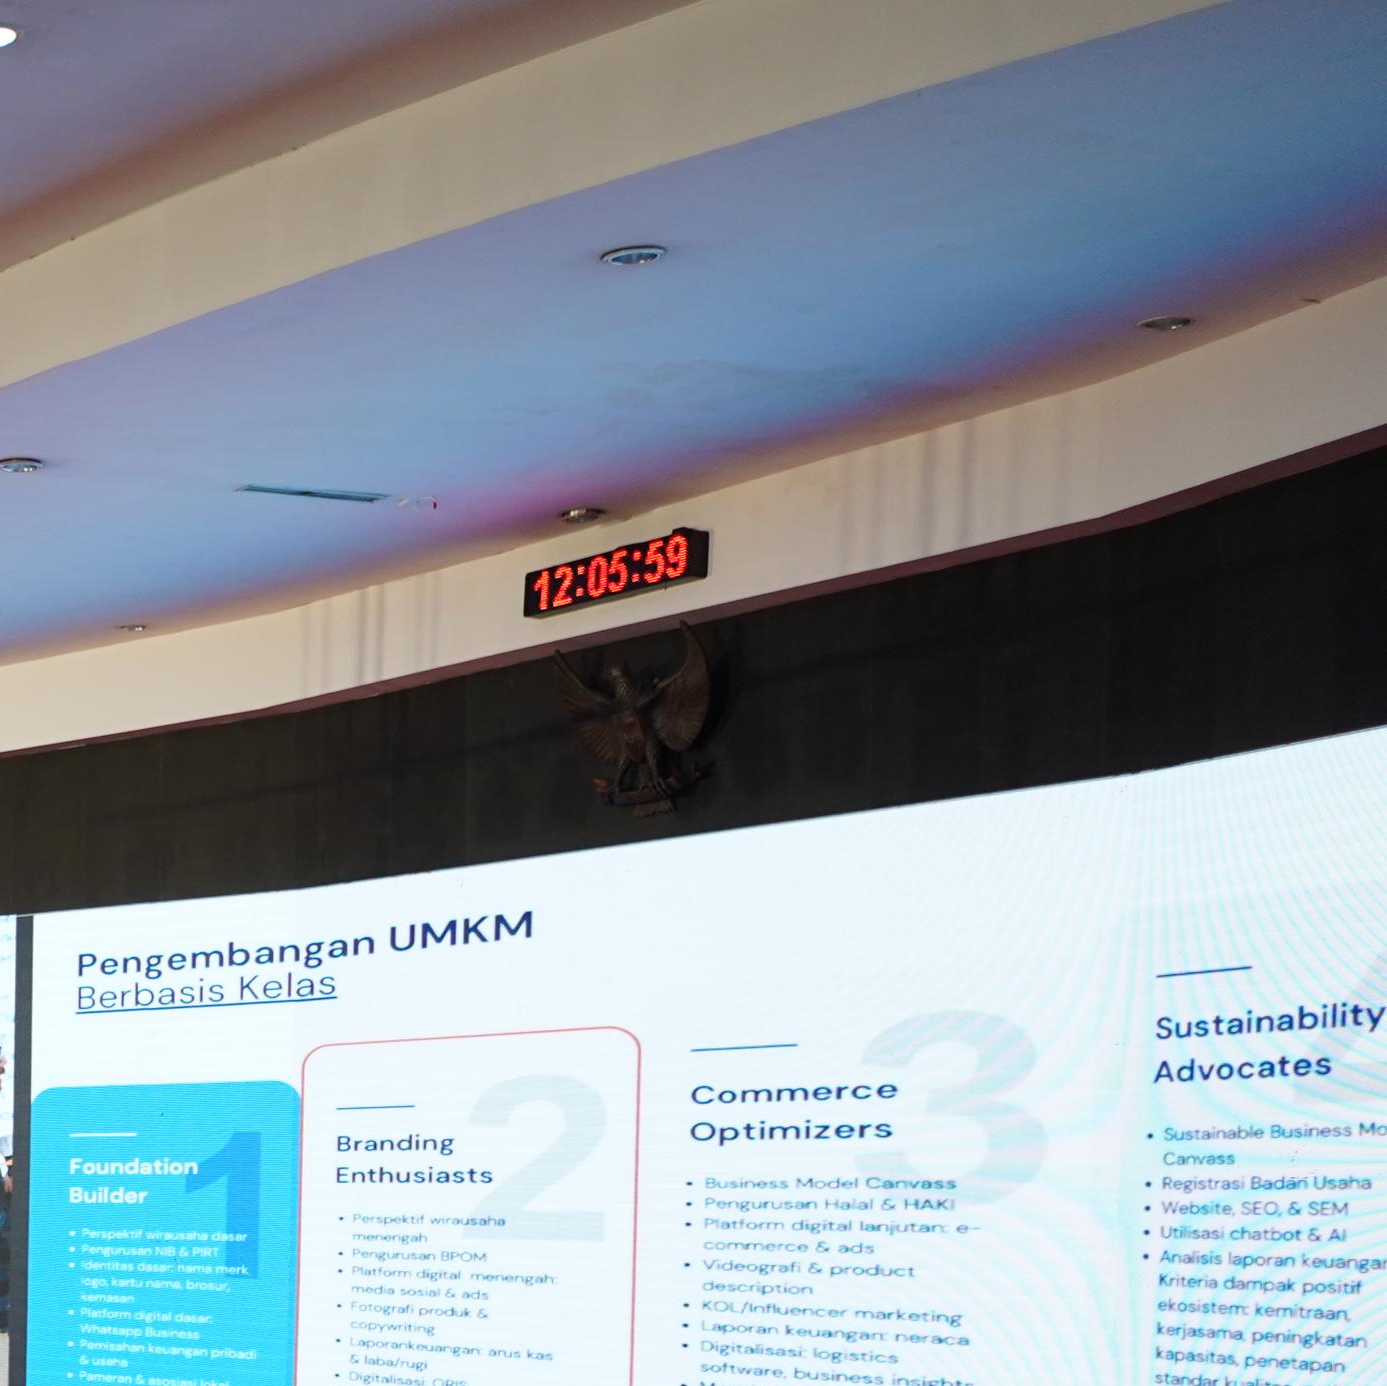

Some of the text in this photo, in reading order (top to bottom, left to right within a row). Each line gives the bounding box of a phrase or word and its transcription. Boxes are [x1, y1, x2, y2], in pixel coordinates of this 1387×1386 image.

[532, 534, 689, 610] 12:05:59
[78, 911, 533, 980] Pengembangan UMKM
[77, 973, 336, 1010] Berbasis Kelas
[1157, 1002, 1386, 1039] Sustainability
[1155, 1056, 1332, 1084] Advocates
[691, 1080, 898, 1105] Commerce
[854, 1009, 1048, 1205] 3
[690, 1120, 893, 1145] Optimizers
[1164, 1125, 1352, 1141] Sustainable Business
[337, 1134, 455, 1156] Branding
[461, 1073, 607, 1241] 2
[1163, 1152, 1235, 1165] Canvass
[70, 1158, 198, 1175] Foundation
[336, 1166, 493, 1183] Enthusiasts
[705, 1177, 956, 1190] Business Model Canvass
[1162, 1176, 1372, 1193] Registrasi Badan Usaha
[70, 1187, 148, 1203] Builder
[185, 1131, 261, 1279] 1
[705, 1198, 955, 1214] Pengurusan Halal & HAKI
[1288, 1202, 1301, 1215] &
[1308, 1202, 1349, 1215] SEM
[353, 1213, 505, 1226] Perspektif wirausaha
[704, 1218, 785, 1232] Platform
[791, 1219, 853, 1236] digital
[82, 1228, 247, 1242] Perspektif wirausaha dasar
[352, 1232, 427, 1245] menengah
[1161, 1226, 1346, 1241] Utilisasi chatbot & AI
[82, 1244, 219, 1257] Pengurusan NIB & PIRT
[703, 1239, 874, 1254] commerce & ads
[352, 1249, 487, 1263] Pengurusan BPOM
[1160, 1250, 1295, 1269] Analisis laporan
[178, 1264, 213, 1273] nama
[352, 1266, 461, 1282] Platform digital
[703, 1259, 915, 1281] Videografi & product
[112, 1278, 143, 1288] kartu
[703, 1279, 813, 1299] description
[1159, 1274, 1362, 1295] Kriteria dampak positif
[81, 1293, 135, 1303] kemasan
[352, 1284, 489, 1300] media sosial & ads
[81, 1308, 172, 1323] Platform digital
[351, 1301, 488, 1319] Fotografi produk &
[702, 1300, 963, 1327] KOL/Influencer marketing
[80, 1324, 200, 1339] Whatsapp Business
[351, 1320, 435, 1336] copywriting
[701, 1320, 970, 1346] Laporan neraca
[1252, 1330, 1367, 1348] peningkatan
[80, 1340, 256, 1360] Pemisahan keuangan pribadi
[489, 1347, 553, 1360] arus kas
[813, 1346, 898, 1366] logistics
[80, 1356, 128, 1367] & usaha
[349, 1354, 427, 1372] & laba/rugi
[1245, 1355, 1345, 1374] penetapan
[79, 1371, 132, 1384] Pameran
[136, 1375, 145, 1385] &
[794, 1367, 884, 1385] business
